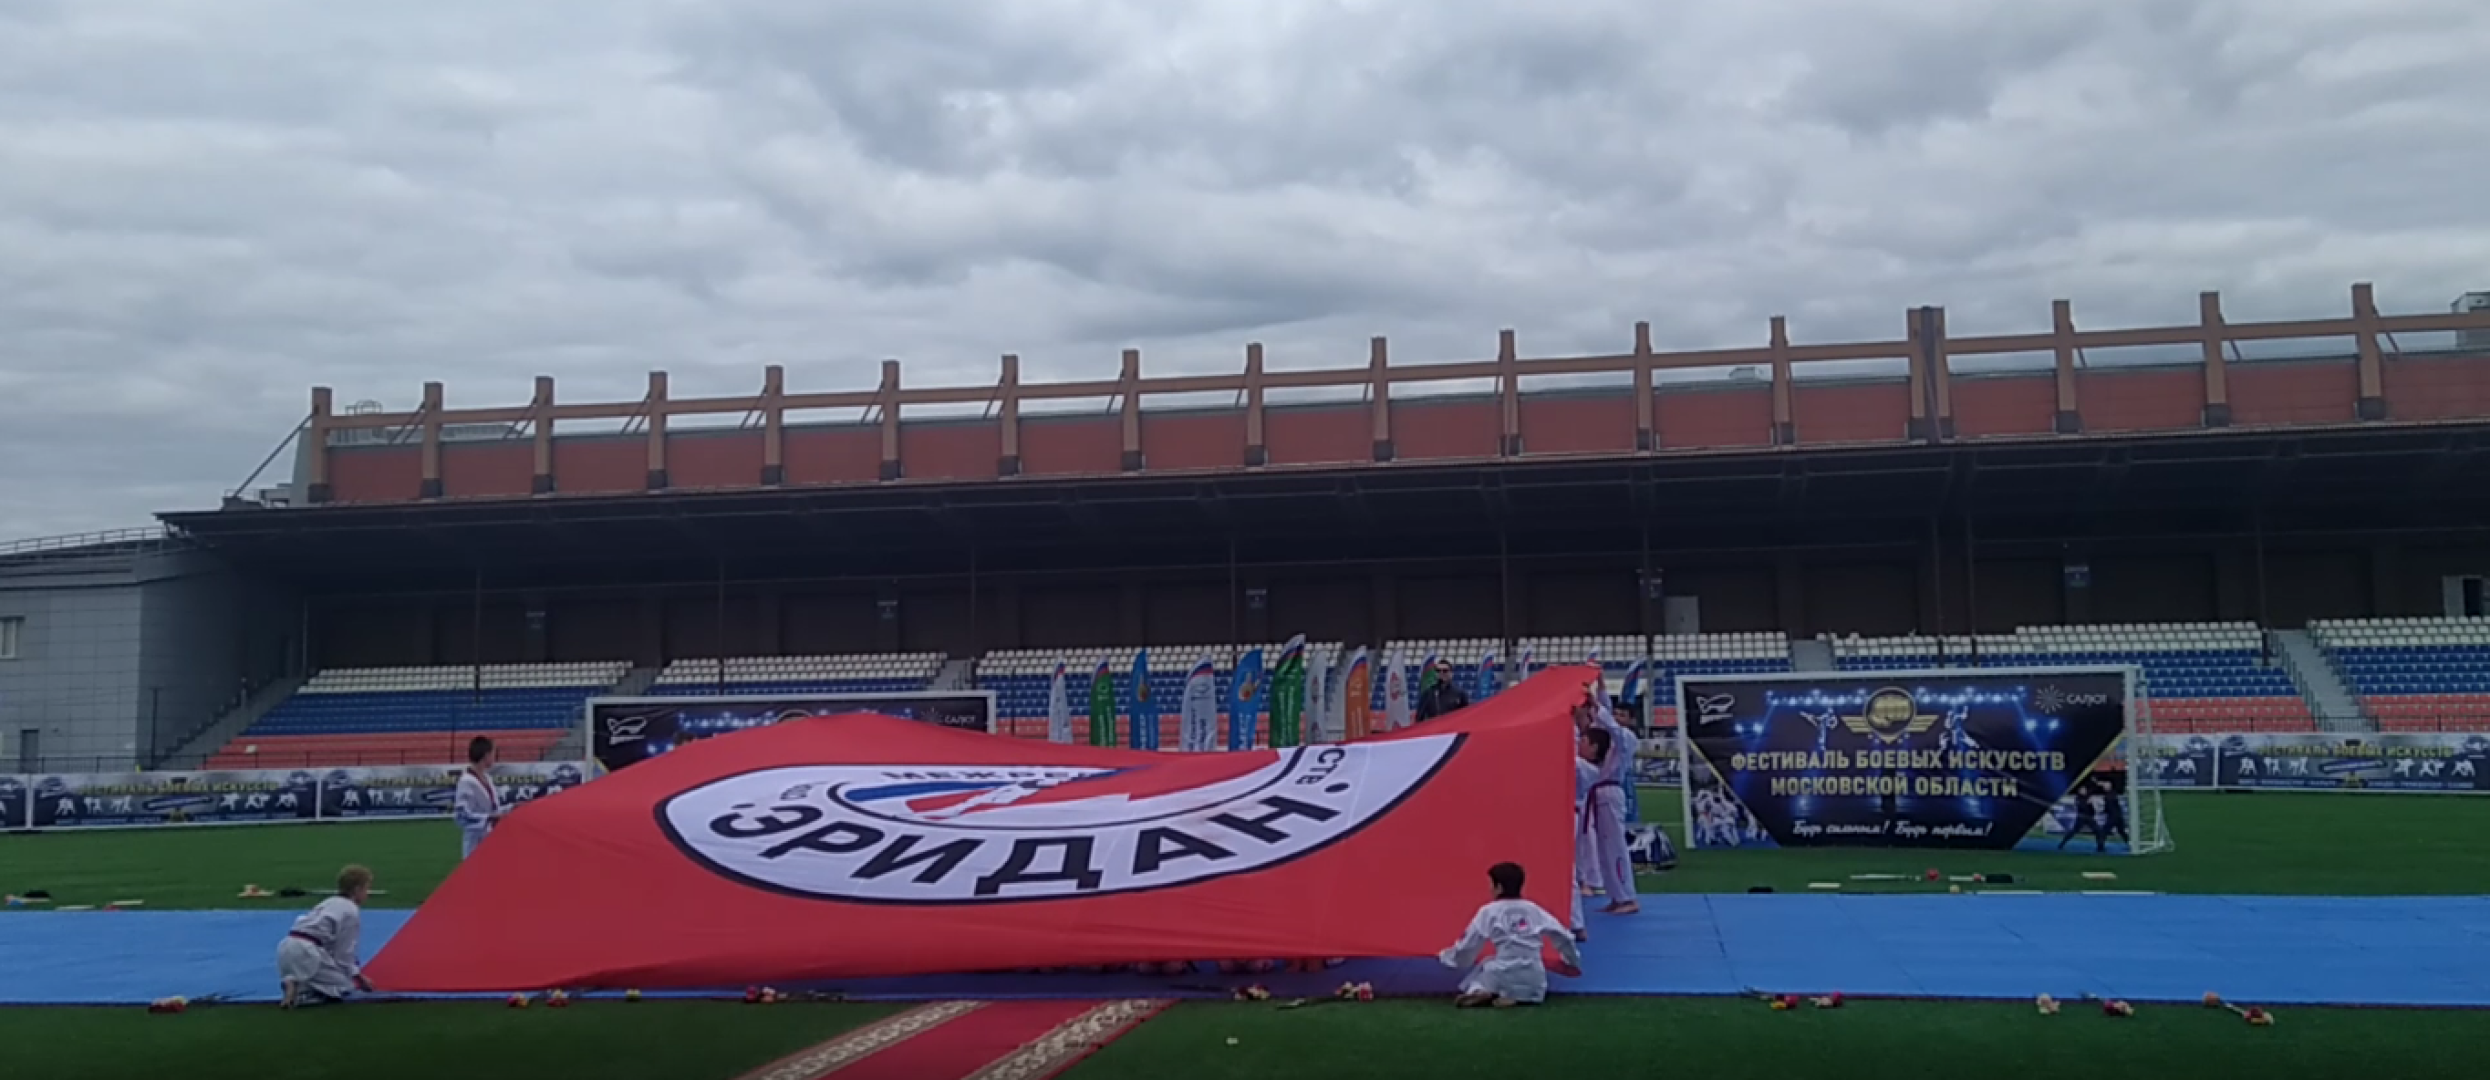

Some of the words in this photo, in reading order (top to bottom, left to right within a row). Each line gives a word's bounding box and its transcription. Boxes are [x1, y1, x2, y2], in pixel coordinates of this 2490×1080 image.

[1731, 750, 1850, 771] ФЕСТИВАЛЬ
[1855, 750, 1943, 769] БОЕВЫХ
[1949, 750, 2066, 771] ИСКУССТВ
[1770, 772, 1909, 797] МОСКОВСКОЙ
[1915, 777, 2018, 797] ОБЛАСТИ
[709, 795, 1341, 896] ЭРИДАН
